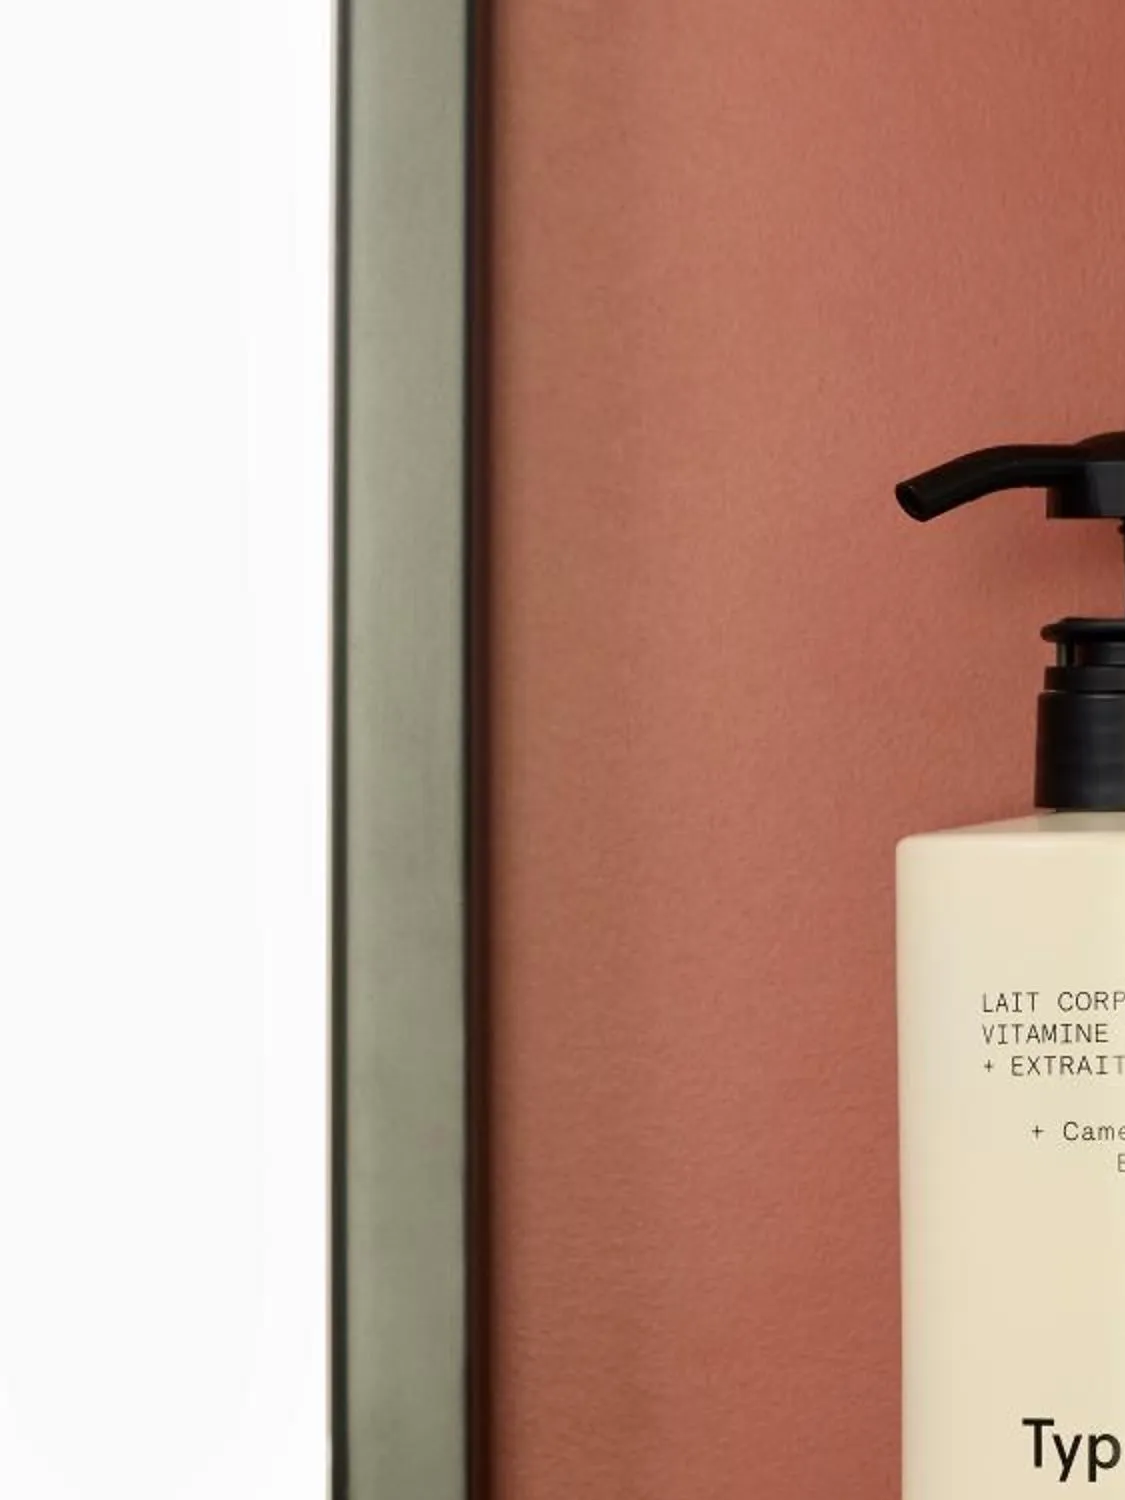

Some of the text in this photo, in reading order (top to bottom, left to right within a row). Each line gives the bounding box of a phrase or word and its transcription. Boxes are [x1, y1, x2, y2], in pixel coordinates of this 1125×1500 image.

[982, 991, 1039, 1013] LAIT
[982, 1023, 1109, 1045] VITAMINE
[984, 1060, 994, 1072] +
[1032, 1125, 1044, 1138] +
